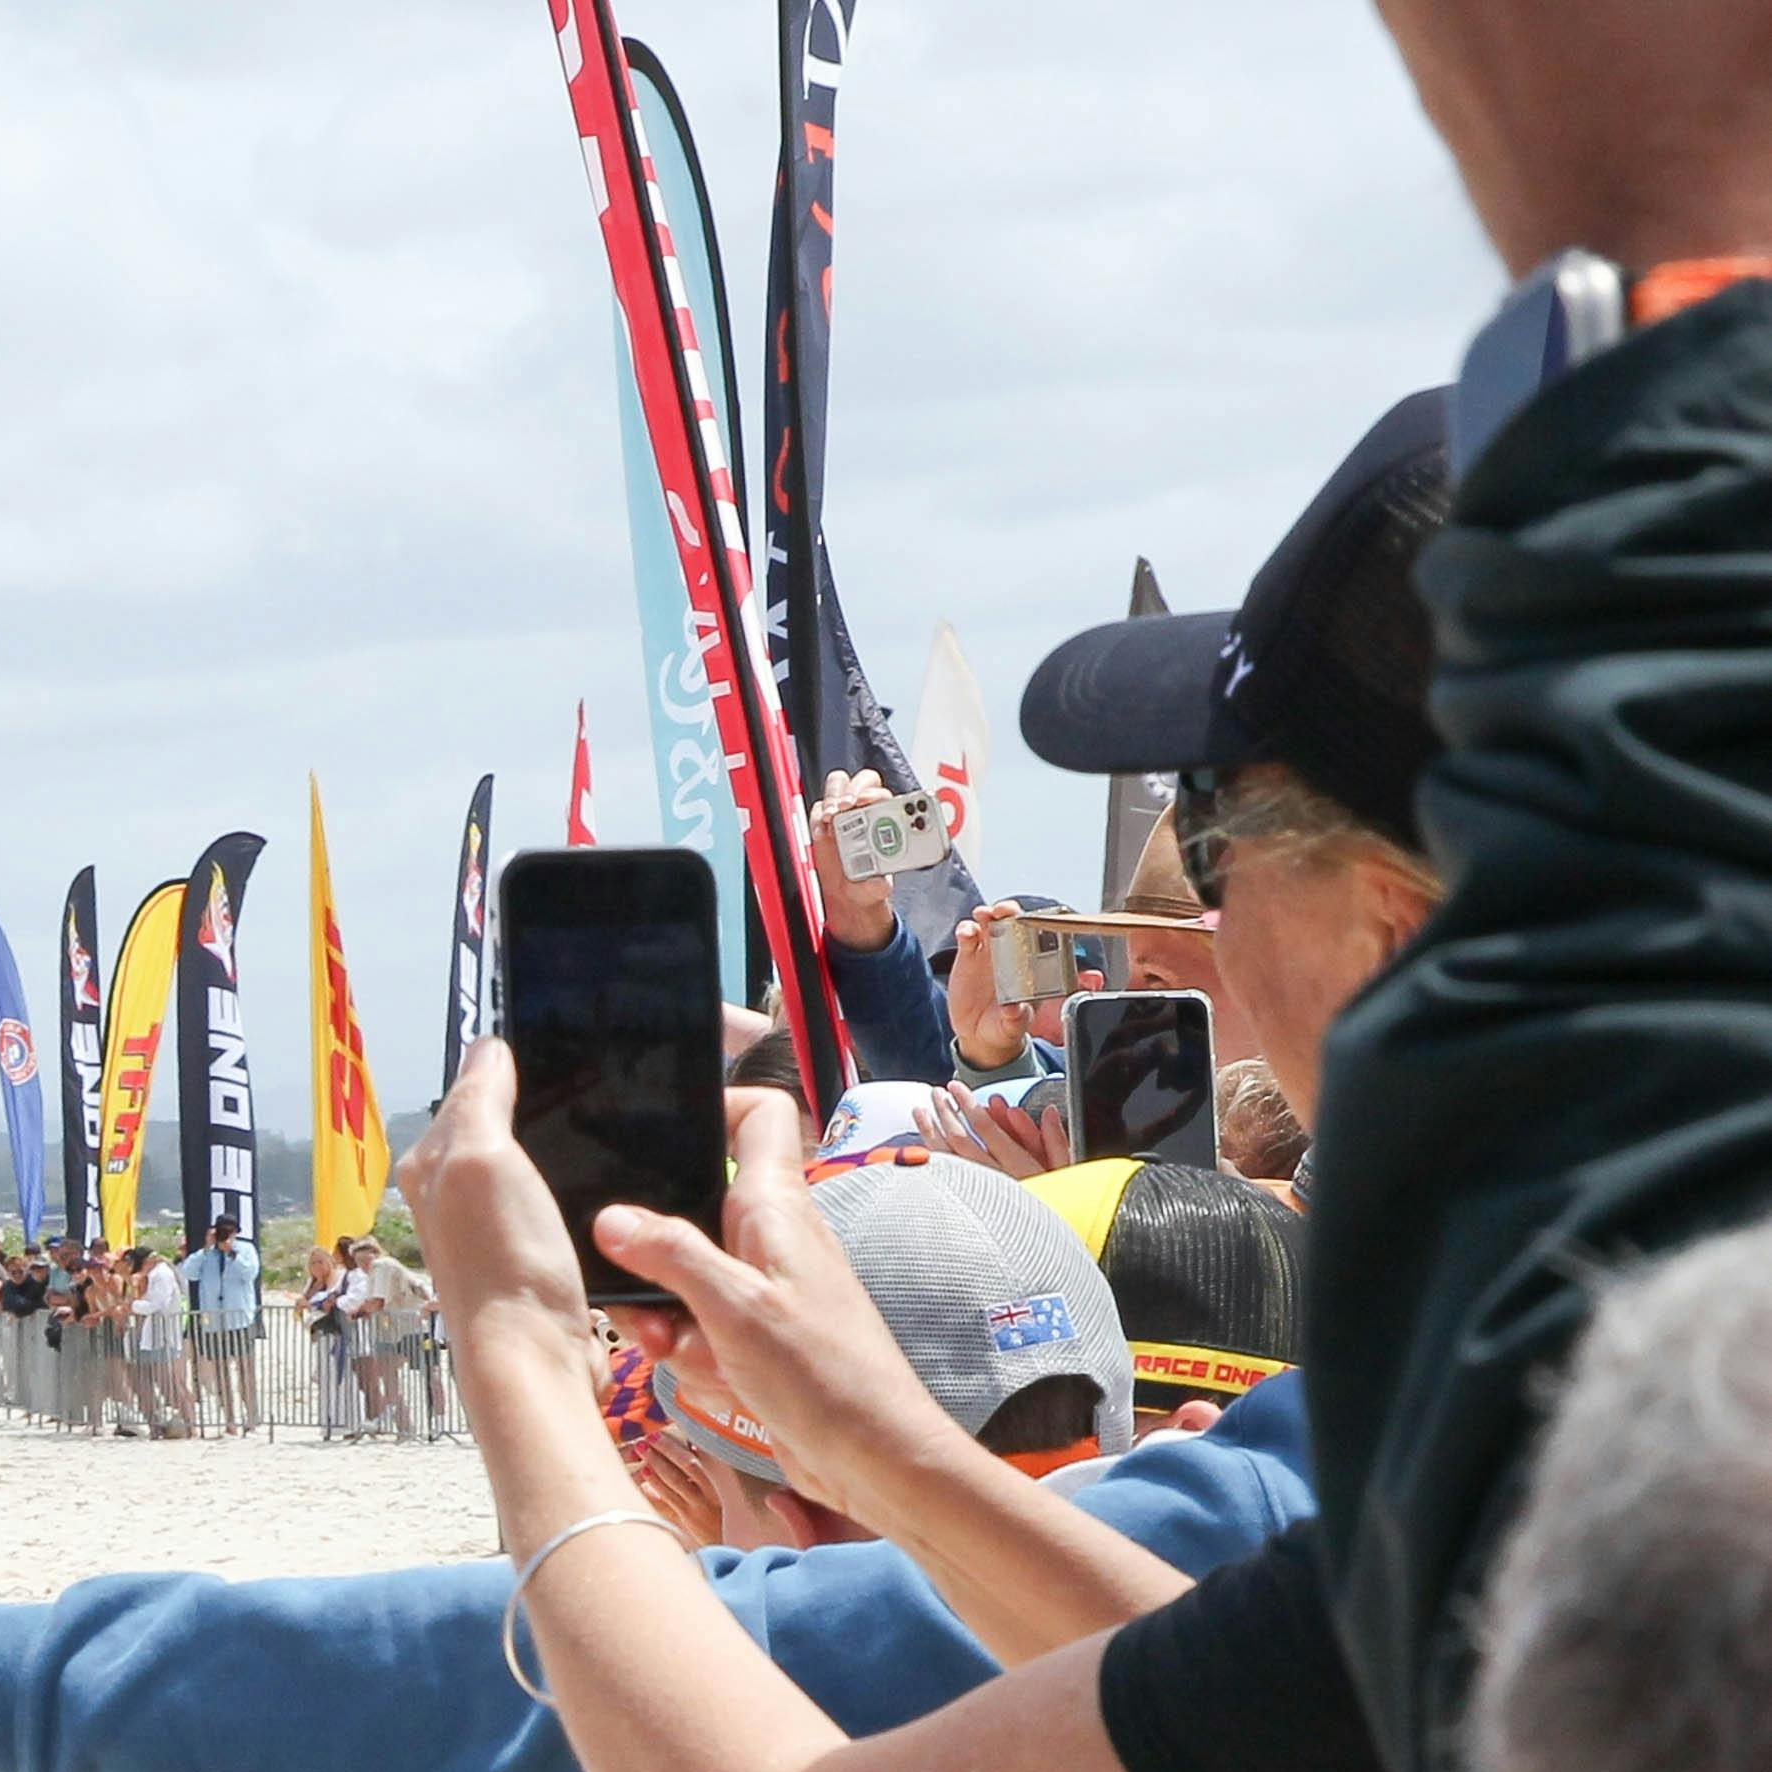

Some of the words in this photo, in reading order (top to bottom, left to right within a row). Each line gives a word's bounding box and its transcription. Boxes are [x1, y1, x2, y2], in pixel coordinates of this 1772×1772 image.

[208, 986, 254, 1131] ONE
[1134, 1354, 1209, 1378] RACE
[733, 1414, 772, 1446] ON
